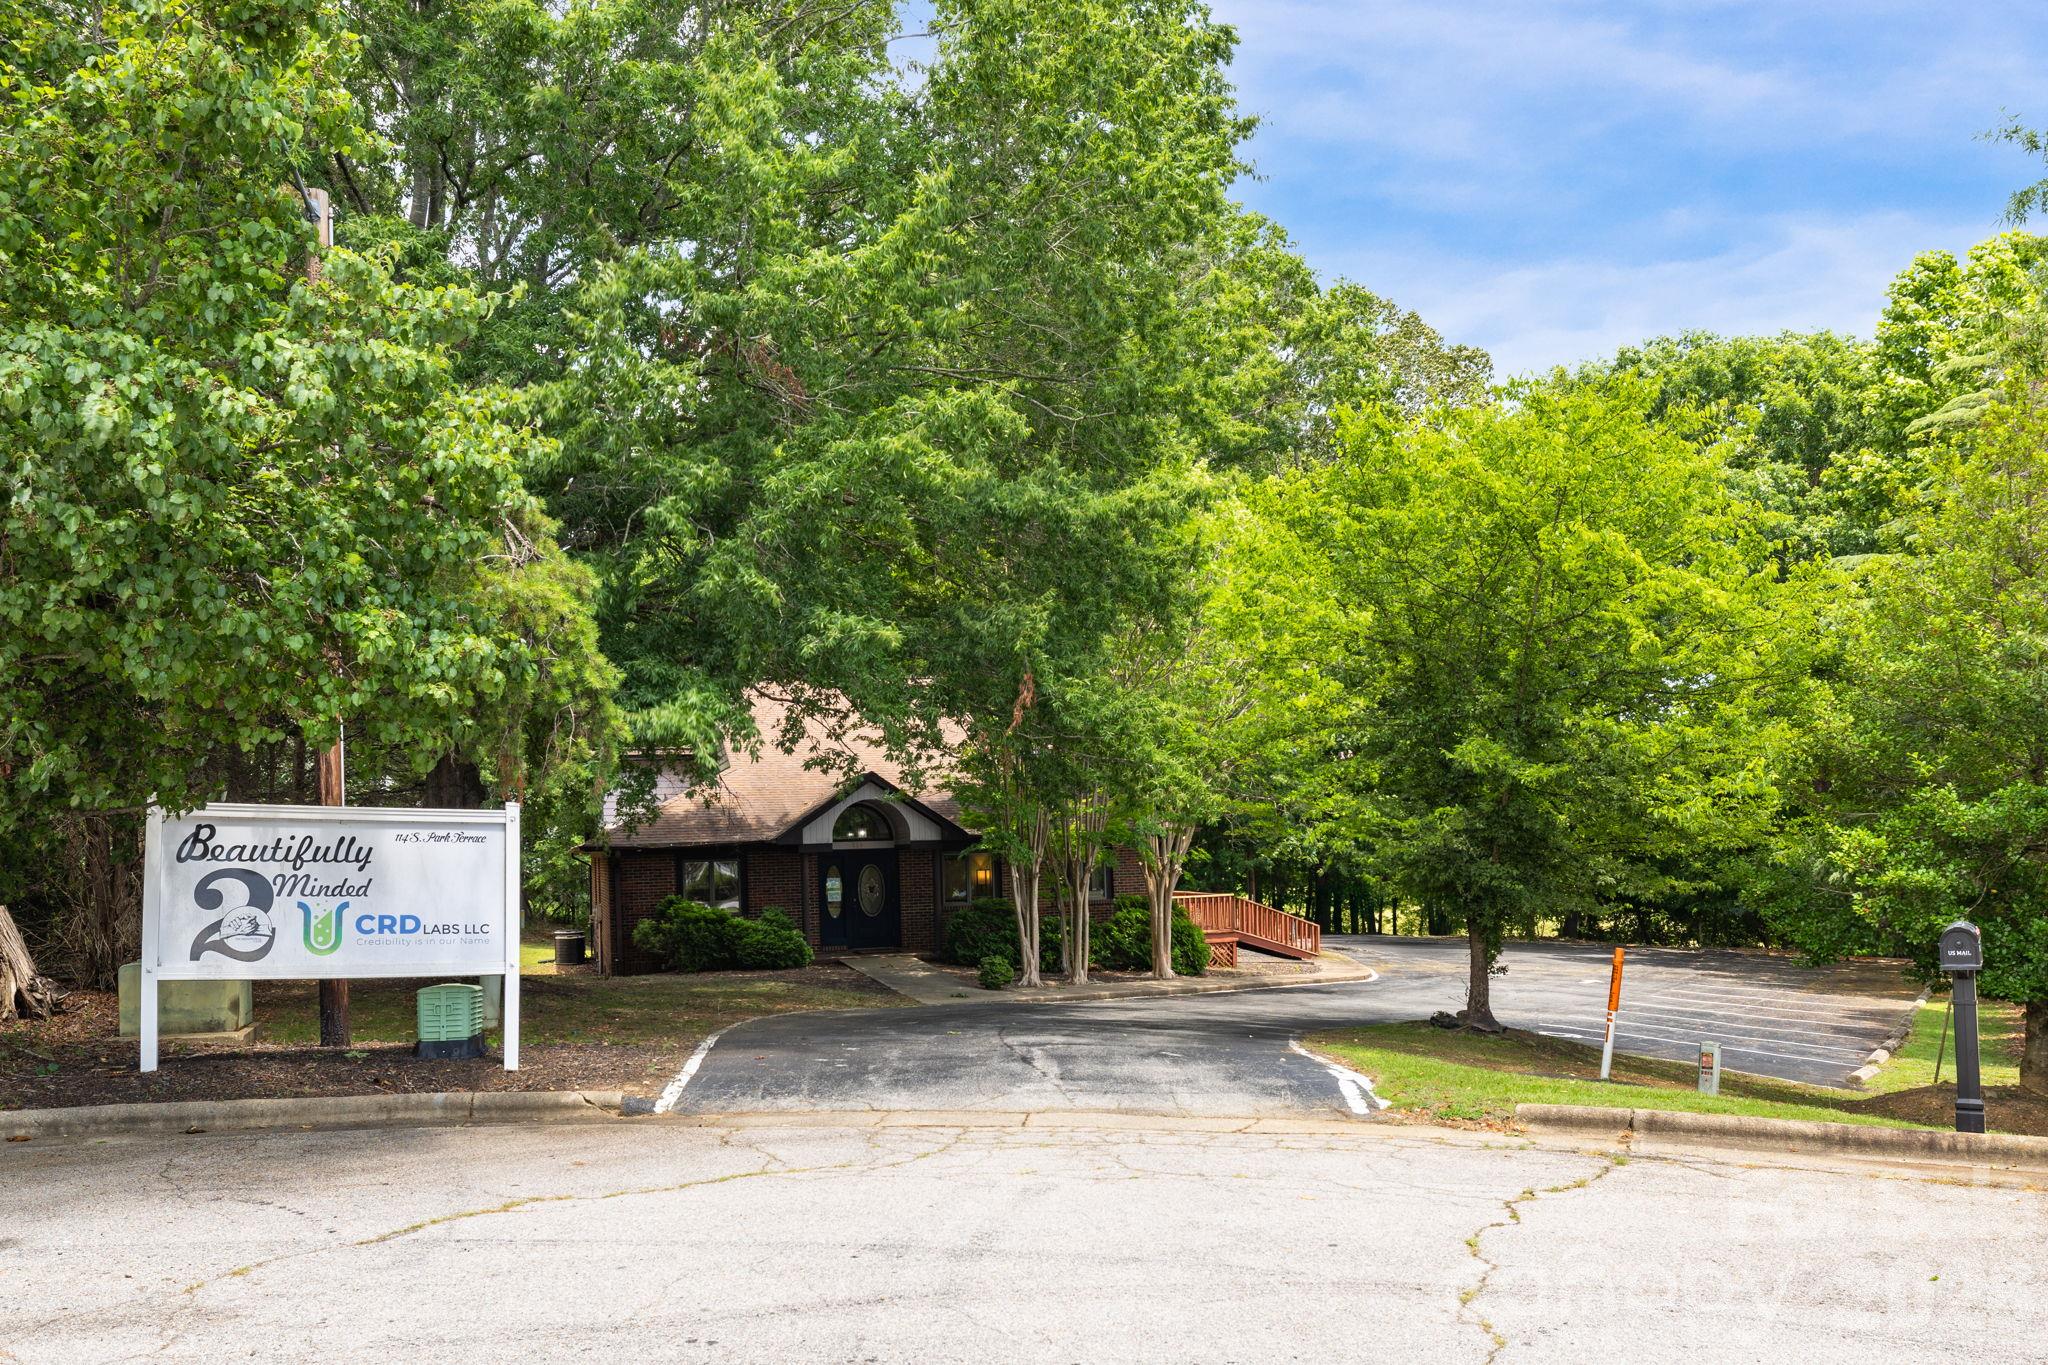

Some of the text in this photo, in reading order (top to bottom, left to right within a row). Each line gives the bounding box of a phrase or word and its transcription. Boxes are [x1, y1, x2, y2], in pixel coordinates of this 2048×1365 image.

[395, 833, 408, 843] 114
[423, 832, 450, 843] Park
[451, 831, 487, 843] Terrace
[176, 824, 373, 872] Beautifully
[272, 873, 373, 897] Minded
[355, 914, 490, 935] CRD LABS LLC
[356, 937, 412, 946] Credibility
[415, 937, 423, 945] is
[460, 937, 490, 945] Name
